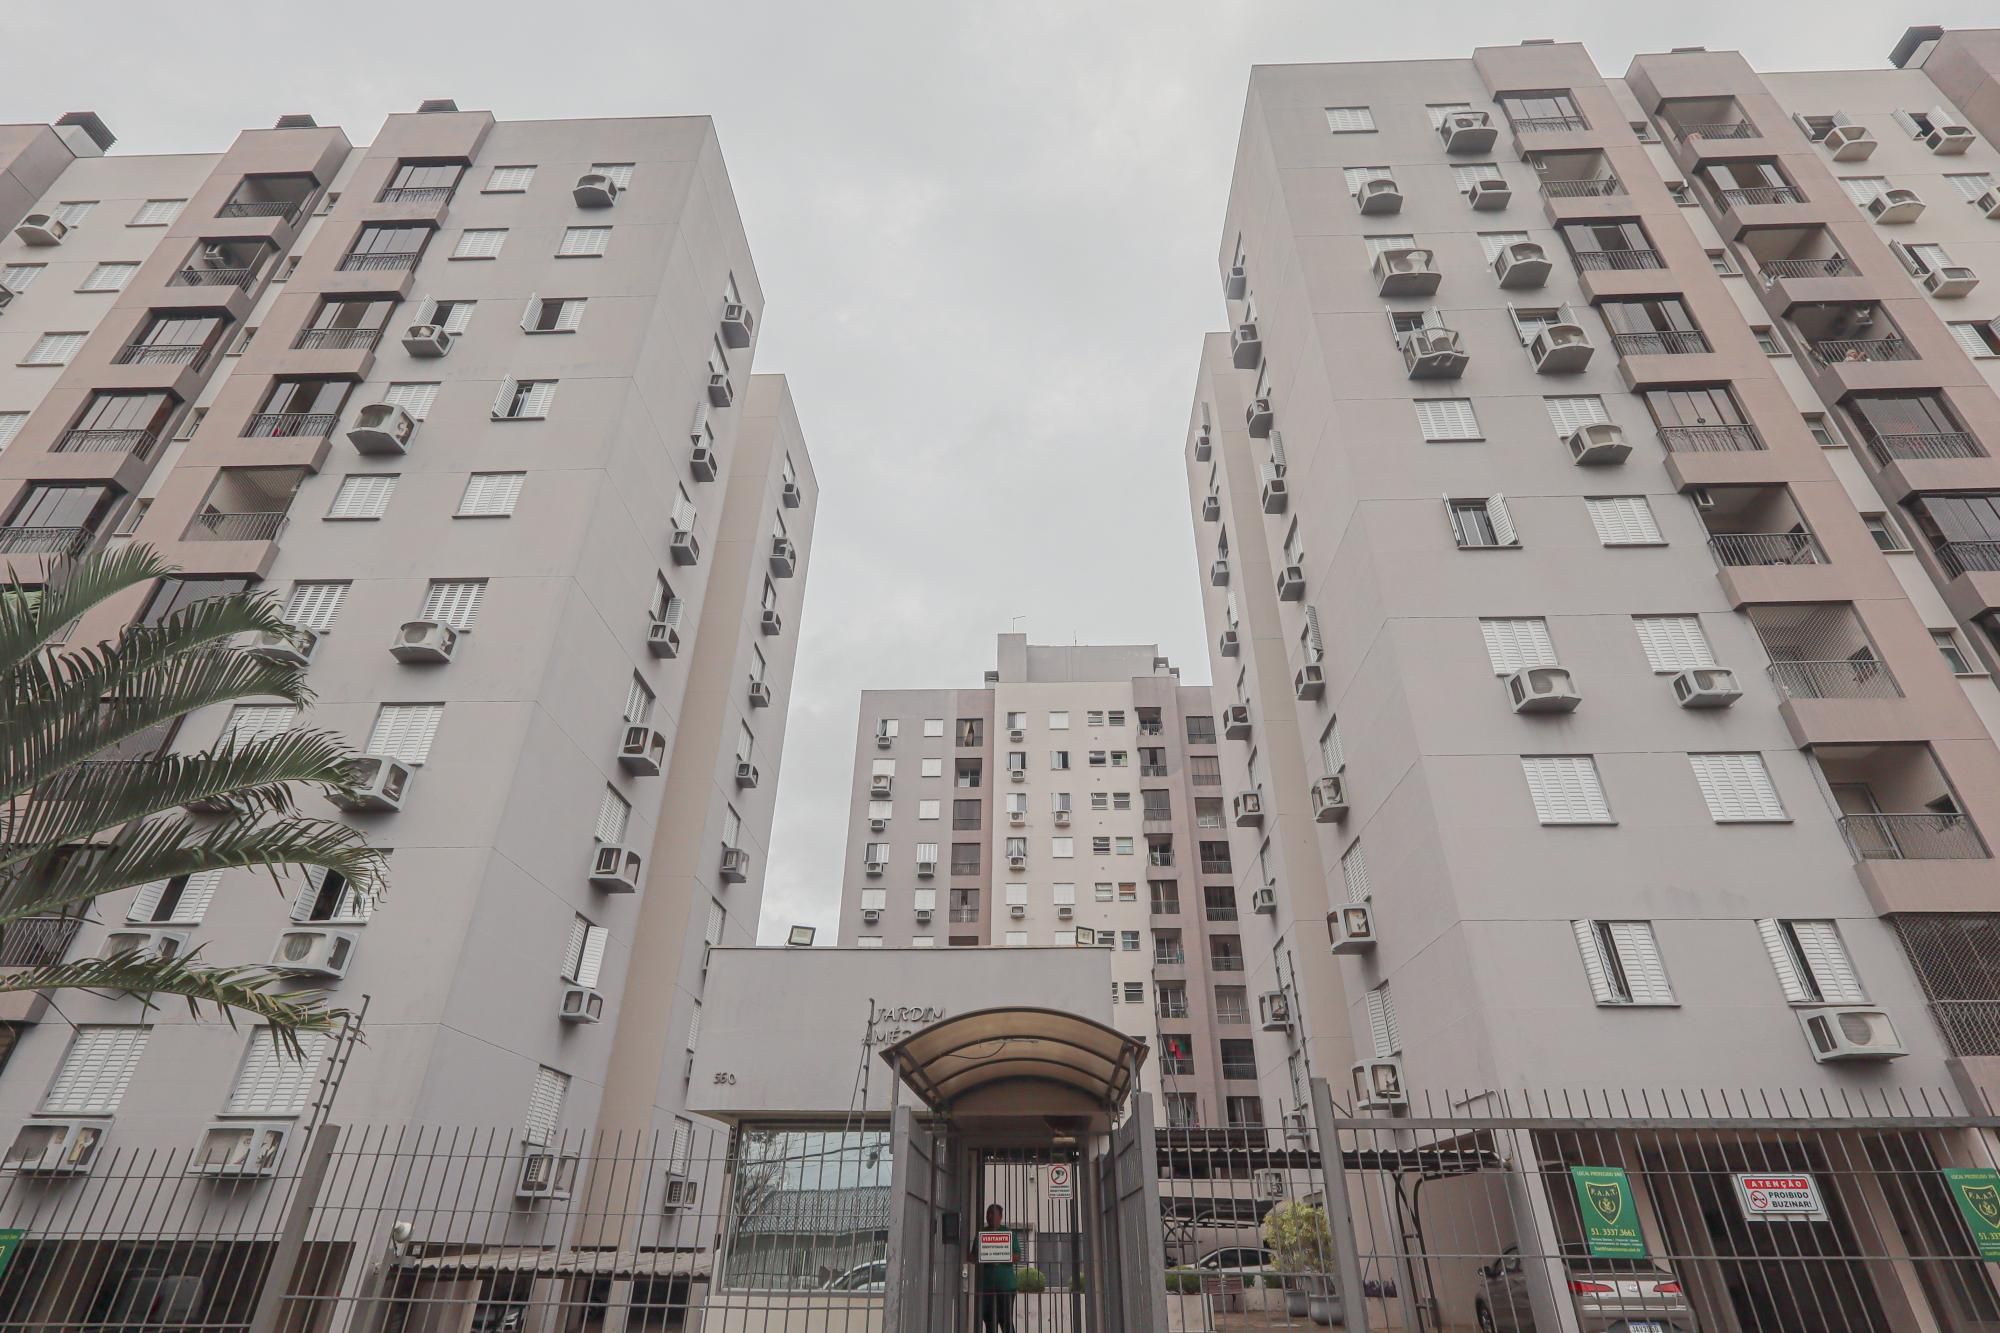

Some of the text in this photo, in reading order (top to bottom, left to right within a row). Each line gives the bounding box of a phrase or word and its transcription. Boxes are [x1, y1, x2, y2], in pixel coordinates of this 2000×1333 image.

[872, 1007, 945, 1025] JARDIM
[713, 1072, 736, 1086] 560
[1751, 1179, 1802, 1188] ATENÇÃO
[1768, 1191, 1809, 1199] PROIBIDO
[1772, 1200, 1813, 1208] BUZINAR!
